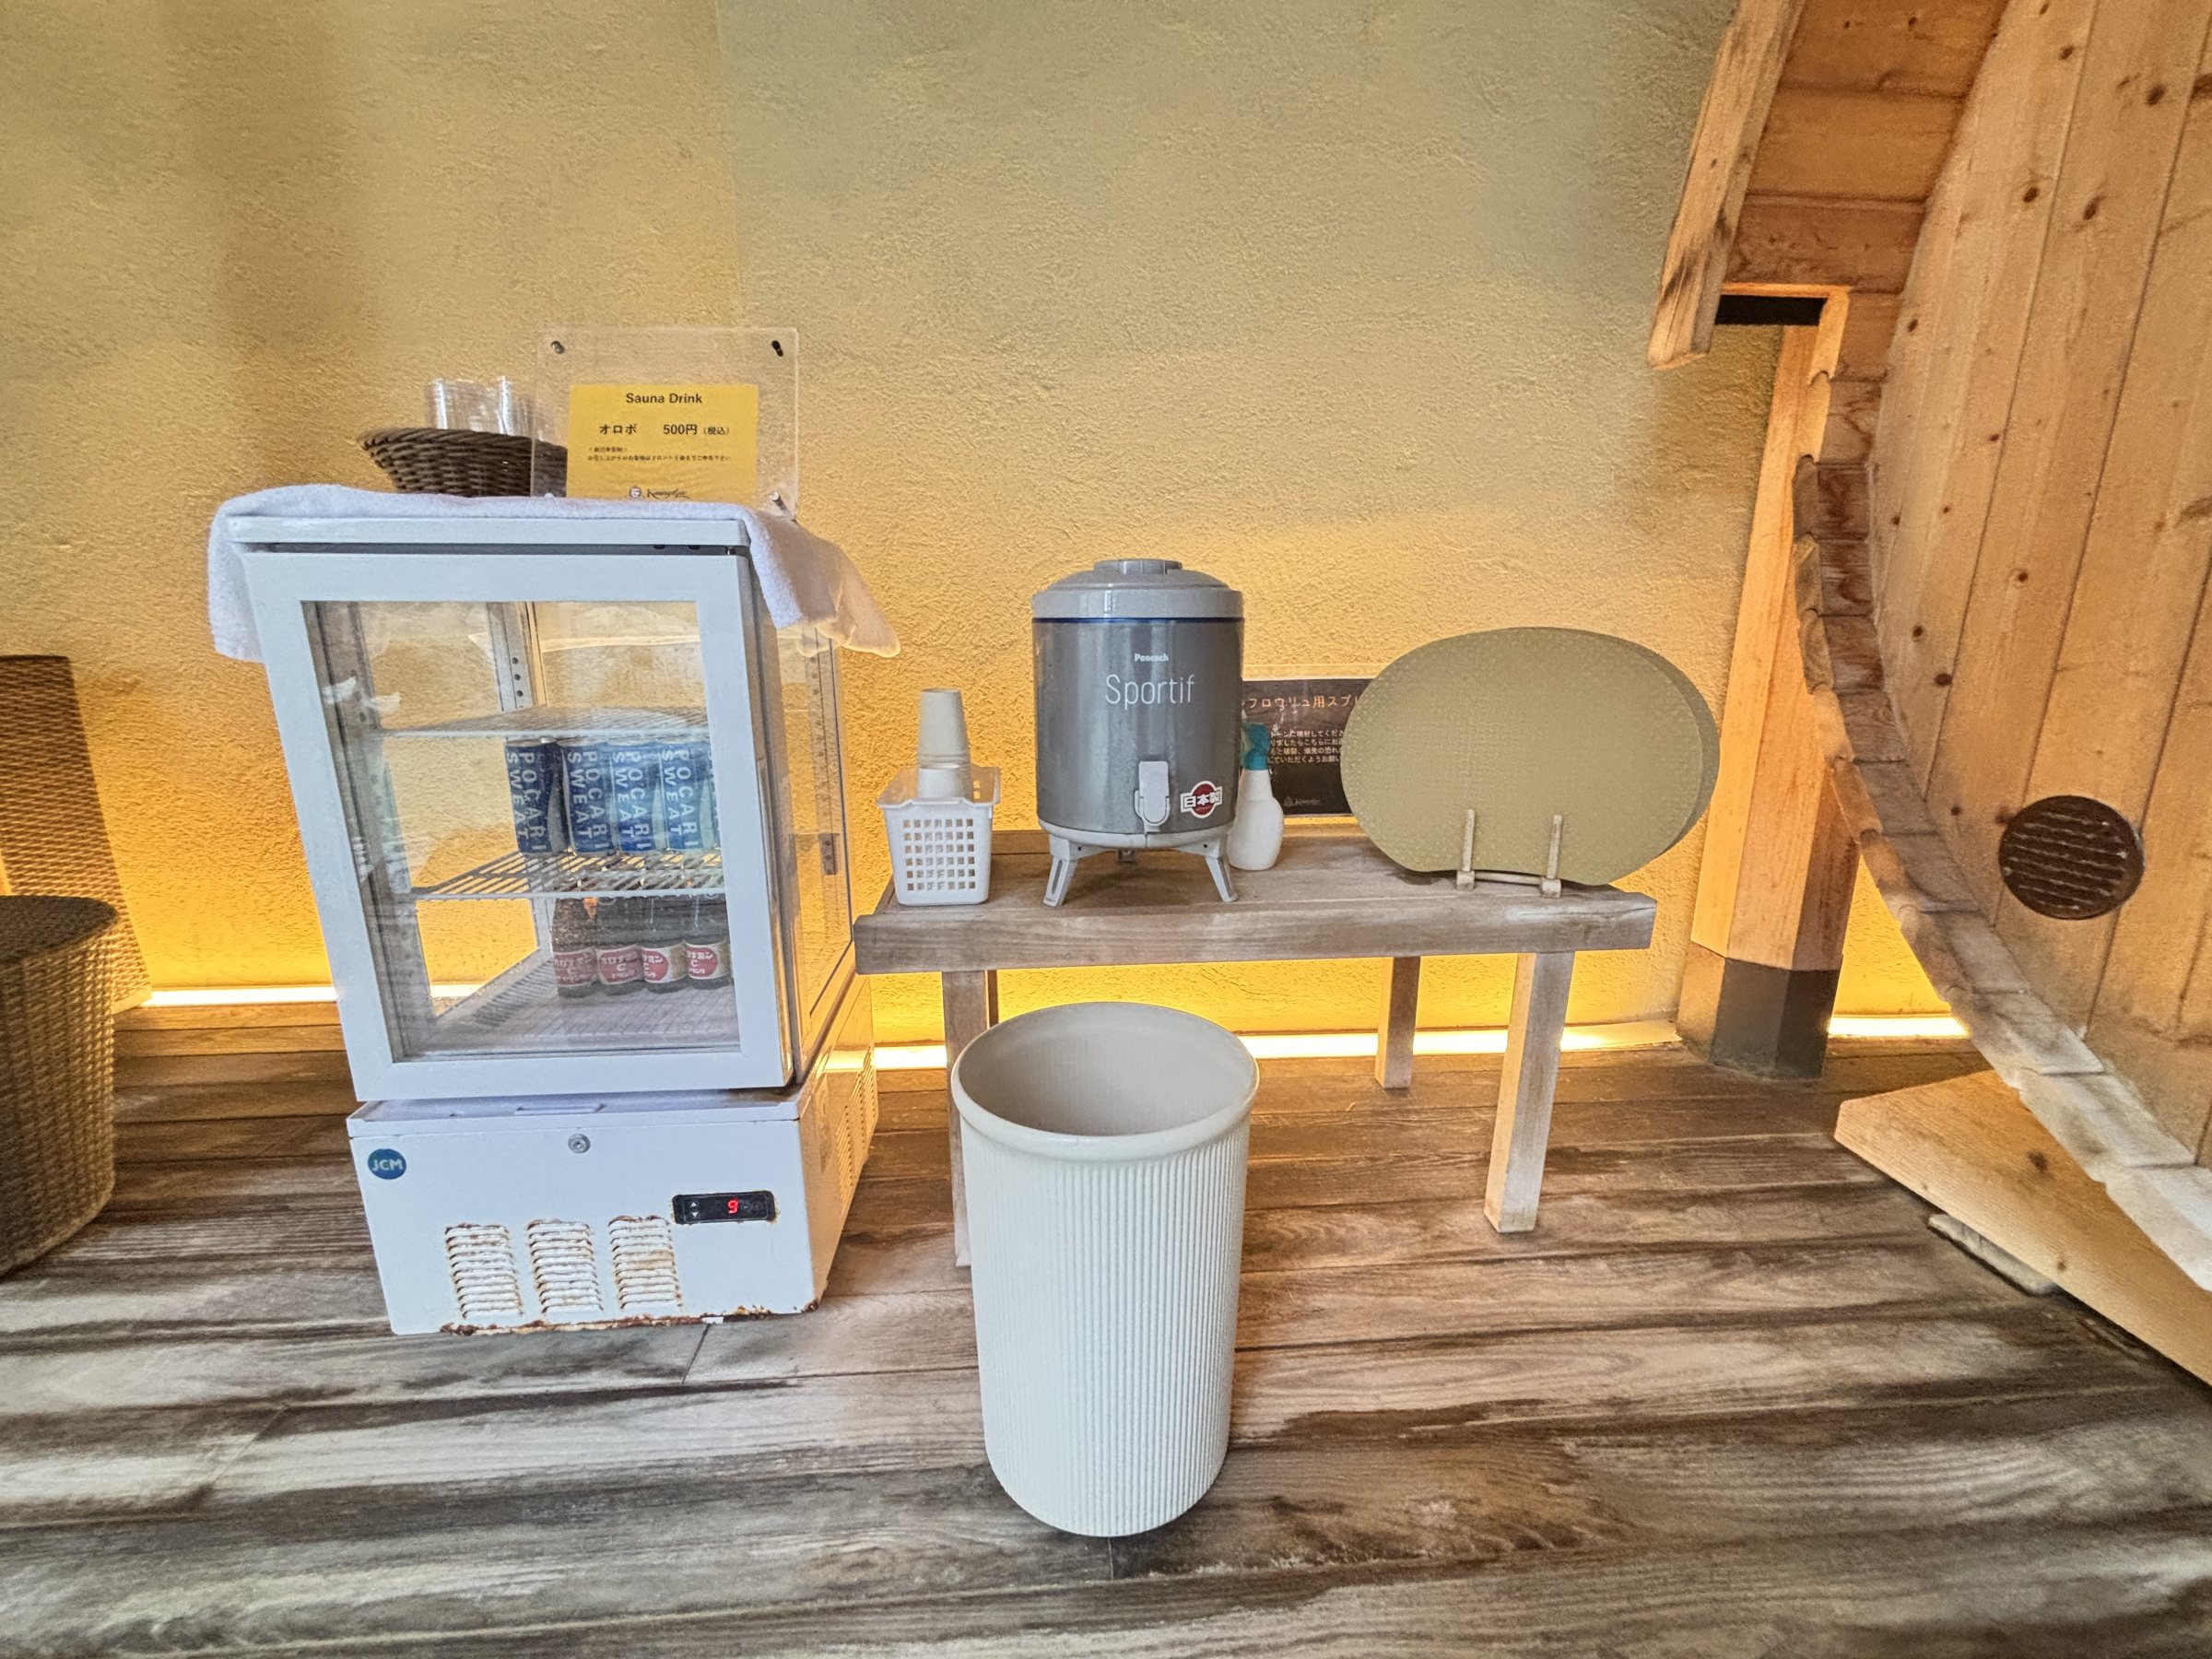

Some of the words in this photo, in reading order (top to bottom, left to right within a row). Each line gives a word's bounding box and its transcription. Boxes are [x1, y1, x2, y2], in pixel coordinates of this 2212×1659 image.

[626, 394, 665, 404] Sauna
[669, 394, 702, 404] Drink
[663, 424, 698, 435] 500円
[1105, 674, 1195, 711] Sportif
[1134, 653, 1170, 663] Peacock
[506, 751, 529, 840] SWEAT
[519, 751, 547, 851] POCARI
[567, 751, 593, 839] SWEAT
[582, 750, 610, 849] POCARI
[612, 750, 635, 838] SWEAT
[625, 750, 653, 850] POCARI
[662, 748, 683, 836] SWEAT
[674, 748, 700, 847] POCARI
[1183, 791, 1220, 808] 日本製
[371, 1157, 404, 1172] JCM
